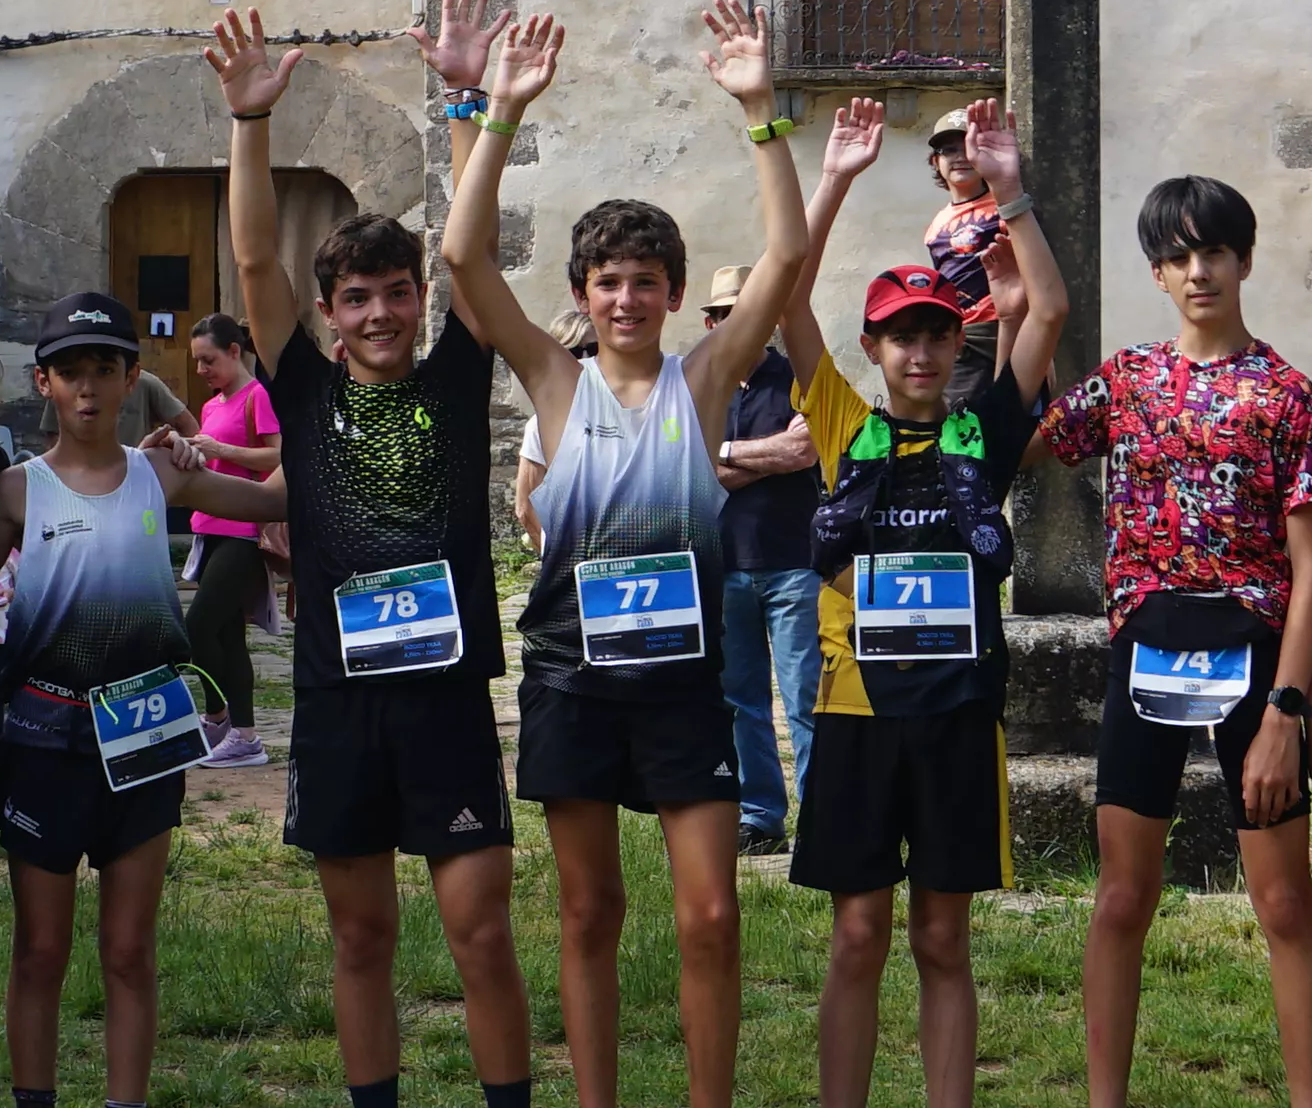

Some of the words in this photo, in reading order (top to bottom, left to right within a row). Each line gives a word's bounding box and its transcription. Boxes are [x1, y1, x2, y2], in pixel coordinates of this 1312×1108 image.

[615, 578, 659, 610] 77
[895, 576, 932, 604] 71
[373, 590, 419, 623] 78
[1170, 650, 1213, 675] 74
[128, 693, 167, 729] 79
